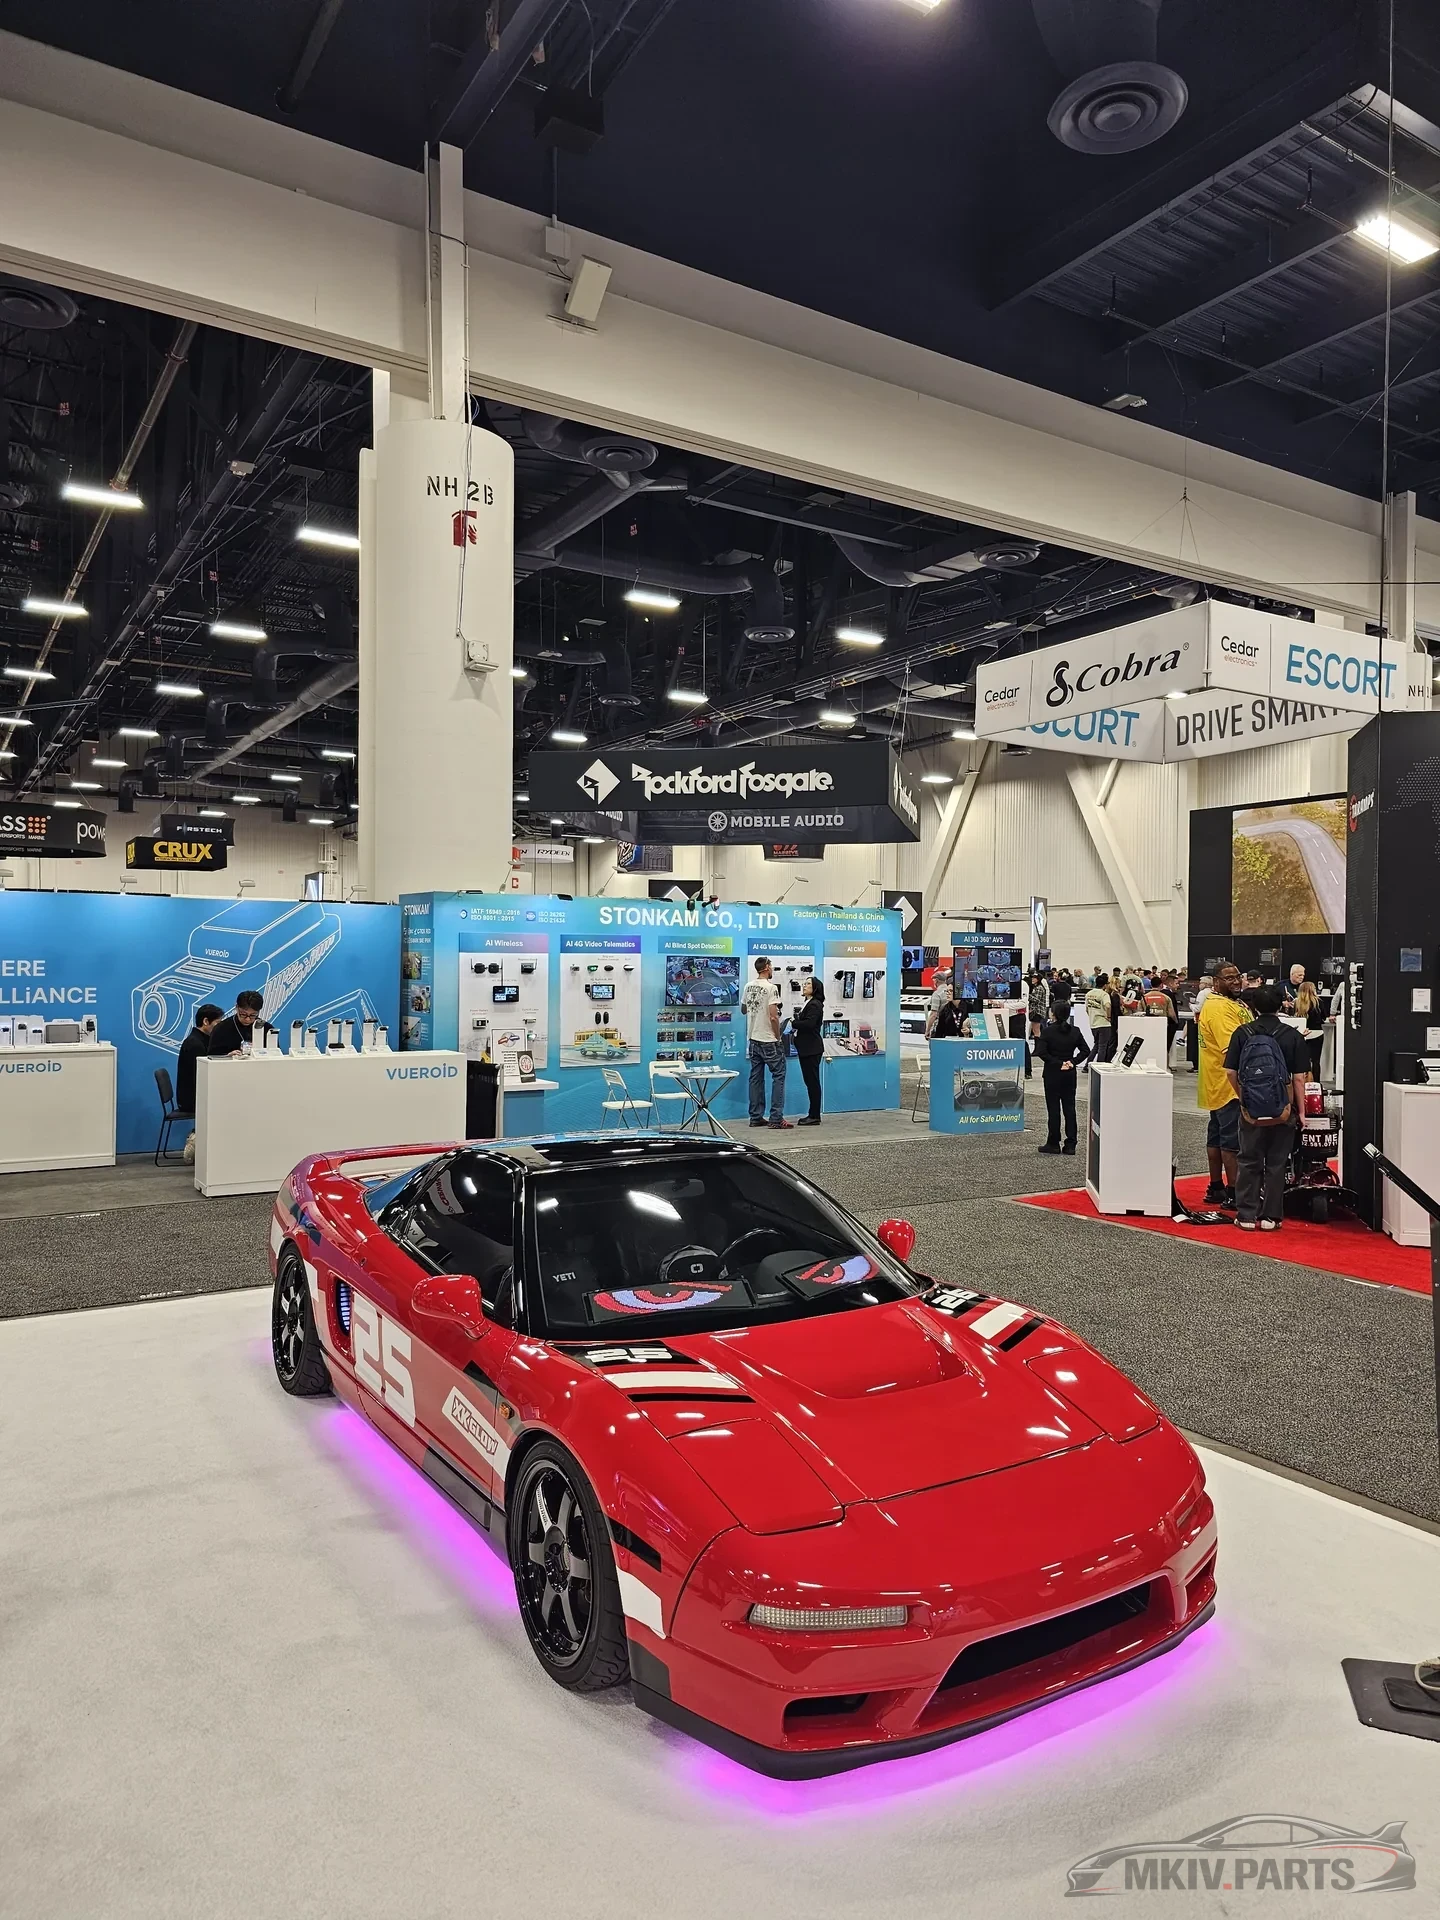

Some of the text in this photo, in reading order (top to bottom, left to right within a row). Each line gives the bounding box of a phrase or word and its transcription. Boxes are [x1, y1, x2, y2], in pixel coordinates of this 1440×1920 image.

[427, 475, 494, 506] NH 2B
[1220, 635, 1259, 658] Cedar
[1223, 654, 1256, 667] electronics
[1076, 649, 1181, 692] Cobra
[1285, 643, 1398, 699] ESCORT
[984, 686, 1020, 704] Cedar
[1408, 684, 1424, 698] NH
[986, 700, 1015, 711] electronics
[1176, 703, 1243, 747] DRIVE
[631, 761, 833, 801] Rockford Fosgate
[0, 815, 27, 832] SS
[730, 814, 845, 828] MOBILE AUDIO
[153, 841, 213, 861] CRUX
[599, 906, 779, 931] STONKAM CO., LTD
[793, 910, 820, 919] Factory
[820, 910, 828, 918] in
[829, 911, 858, 920] Thailand
[858, 912, 864, 920] &
[826, 923, 847, 931] Booth
[2, 960, 46, 977] ERE
[966, 1049, 1015, 1061] STONKAM
[959, 1113, 1021, 1124] All for Safe Driving!
[1302, 1133, 1338, 1143] ENT ME
[552, 1271, 576, 1283] YETI
[353, 1292, 416, 1428] 25
[451, 1394, 499, 1456] XKGLOW
